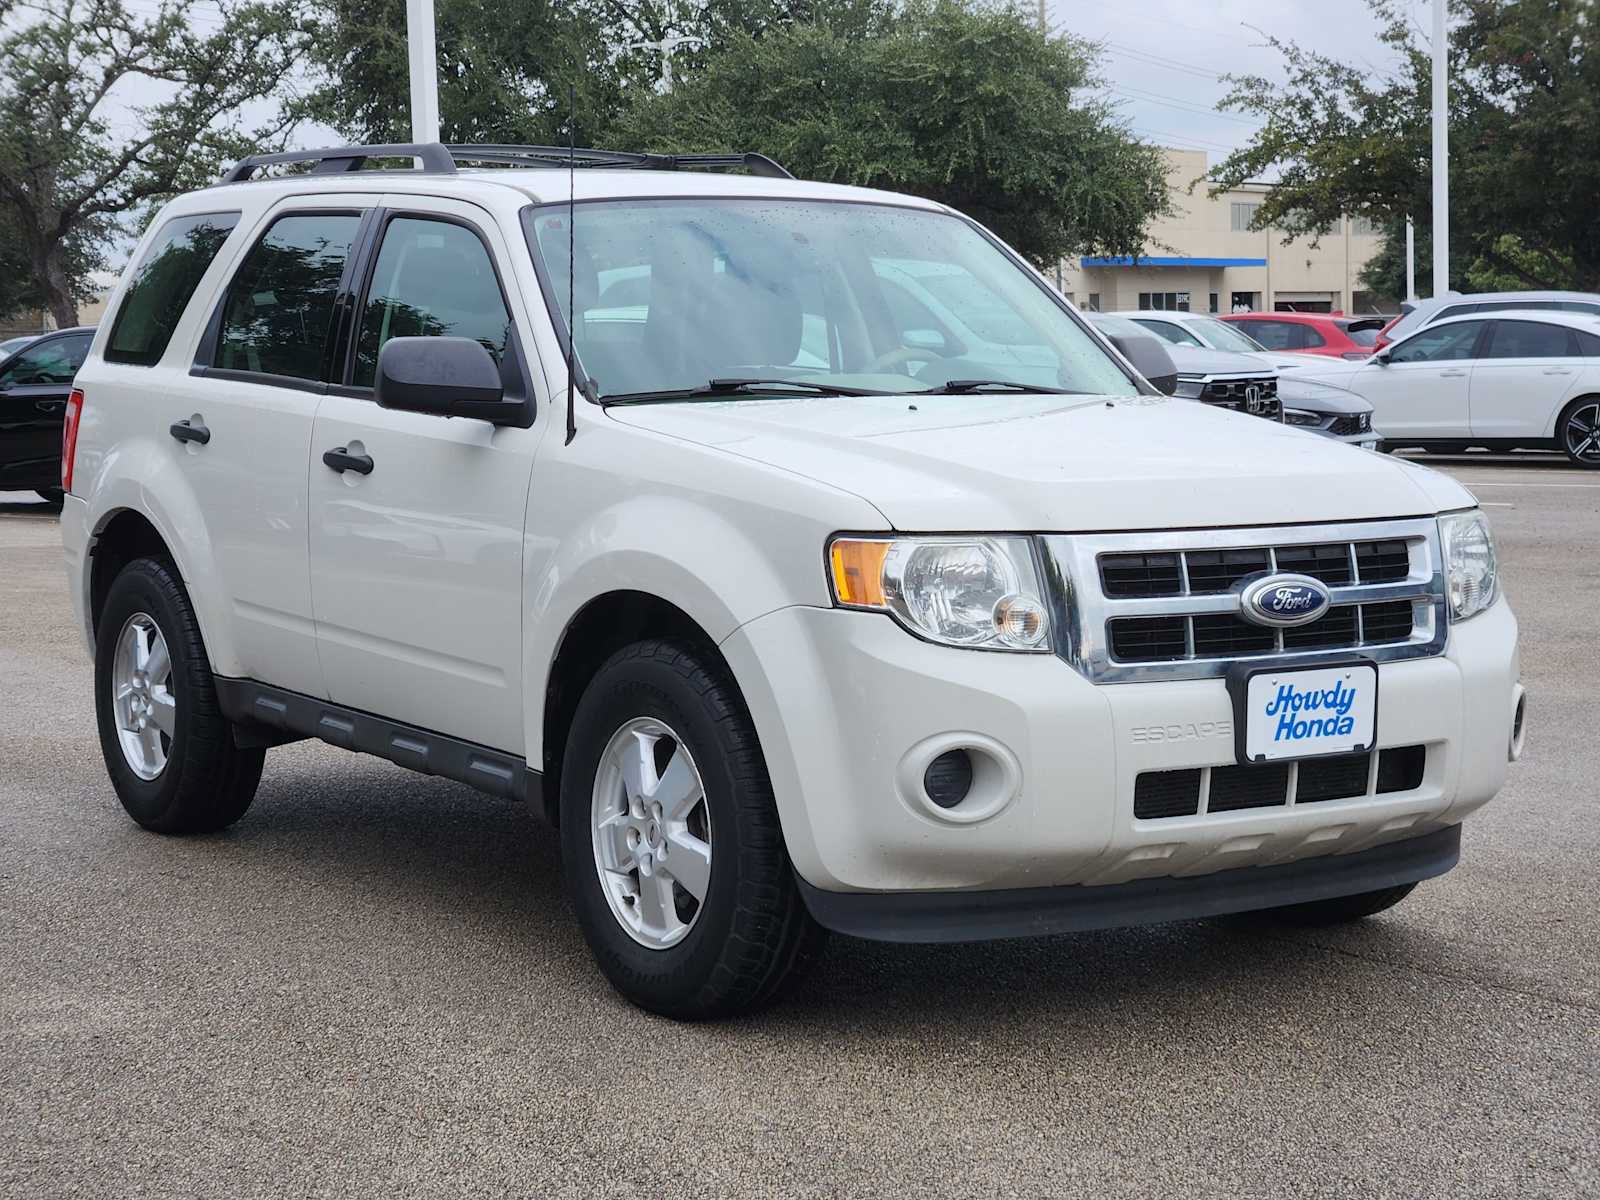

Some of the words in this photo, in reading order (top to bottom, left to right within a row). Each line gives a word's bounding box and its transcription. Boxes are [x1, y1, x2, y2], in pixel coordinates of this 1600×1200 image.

[1273, 588, 1312, 610] Ford
[1265, 680, 1356, 716] Howdy
[1130, 721, 1232, 744] ESCAPE
[1274, 713, 1354, 741] Honda
